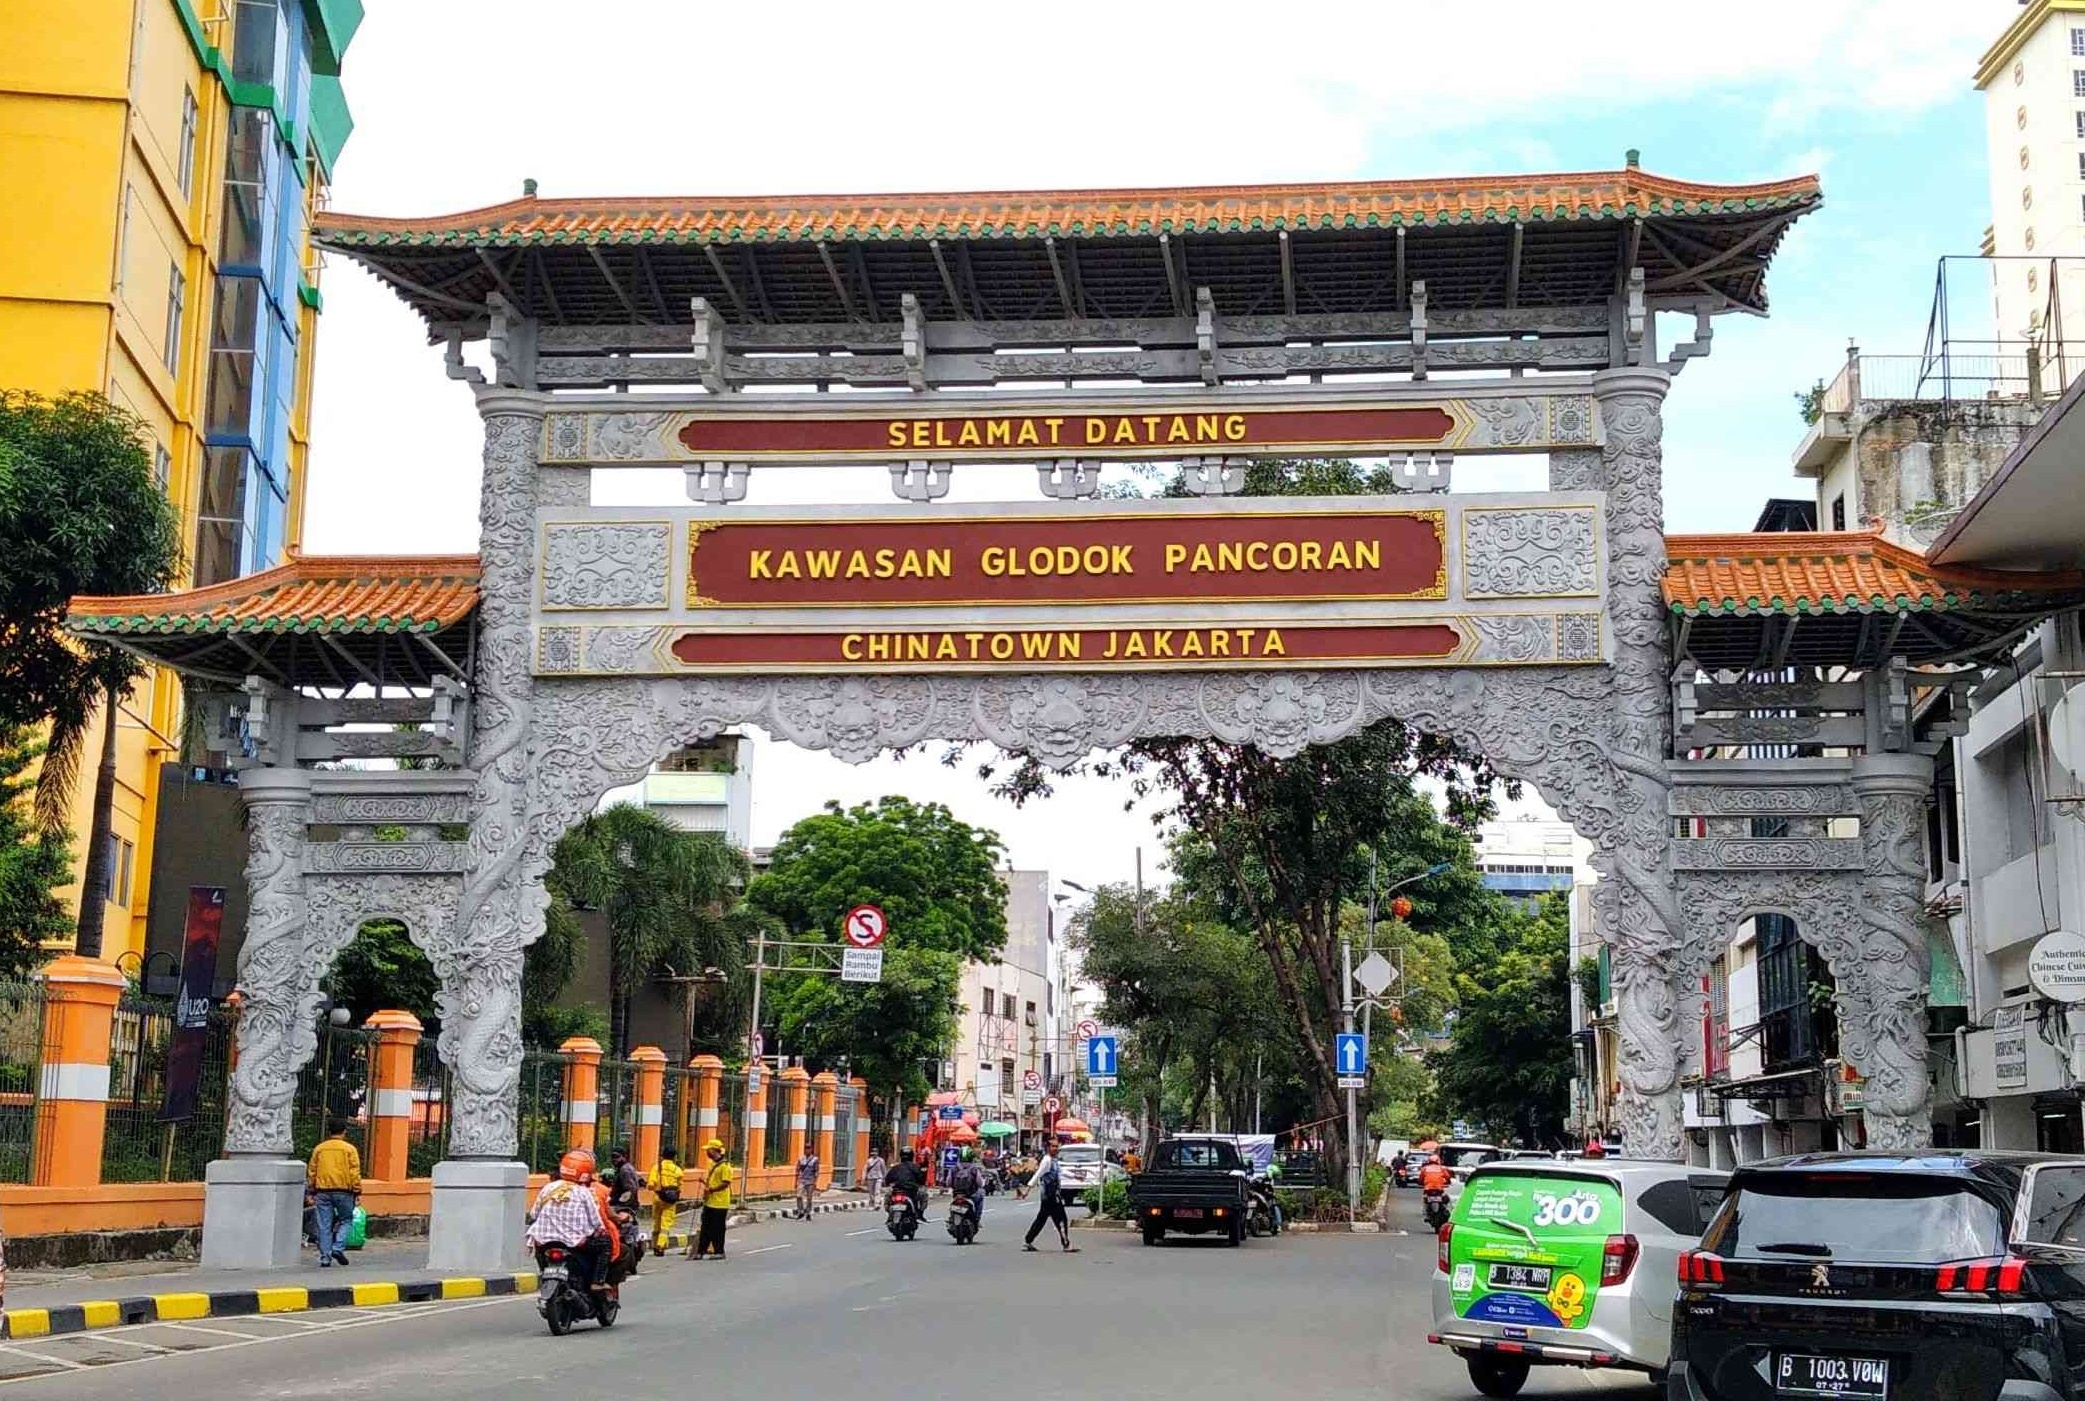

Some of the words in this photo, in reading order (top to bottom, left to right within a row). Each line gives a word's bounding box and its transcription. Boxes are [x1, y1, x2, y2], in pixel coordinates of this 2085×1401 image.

[888, 418, 1063, 447] SELAMAT
[1085, 414, 1247, 444] DATANG
[749, 548, 953, 579] KAWASAN
[981, 544, 1133, 576] GLODOK
[1165, 540, 1382, 571] PANCORAN
[841, 632, 1082, 660] CHINATOWN
[1103, 629, 1286, 657] JAKARTA
[845, 960, 878, 970] Rambu
[846, 951, 880, 960] Sampai
[844, 970, 878, 979] Berikut
[1533, 1195, 1601, 1227] 300
[1781, 1356, 1793, 1377] B
[1808, 1358, 1847, 1380] 1003
